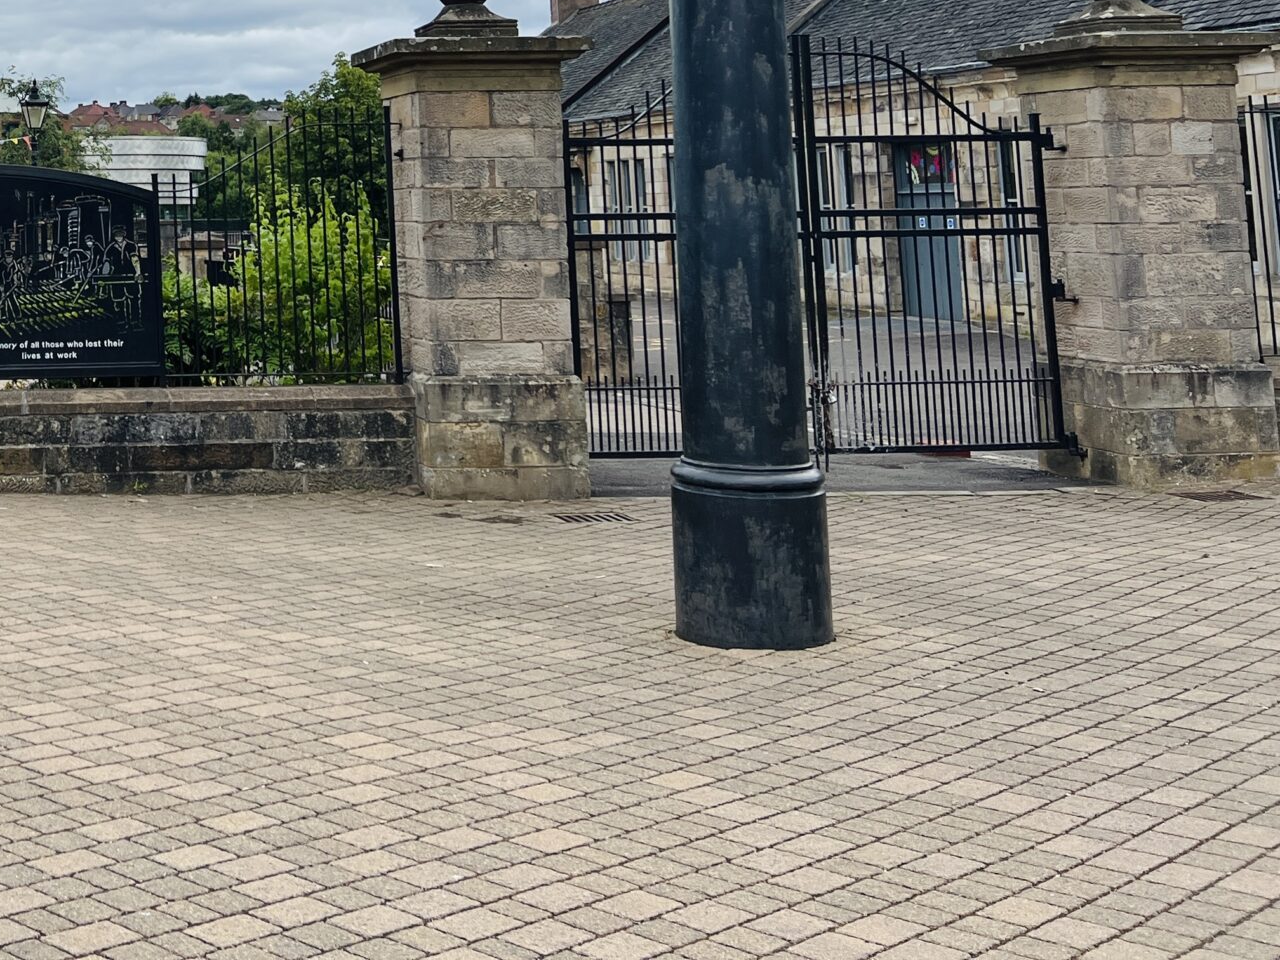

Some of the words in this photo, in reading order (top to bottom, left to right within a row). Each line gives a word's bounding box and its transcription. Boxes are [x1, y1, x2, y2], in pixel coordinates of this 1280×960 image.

[20, 340, 28, 349] of
[30, 341, 40, 349] all
[67, 340, 84, 348] who
[85, 339, 101, 348] lost
[104, 339, 124, 347] their
[22, 352, 41, 360] lives
[57, 351, 77, 359] work
